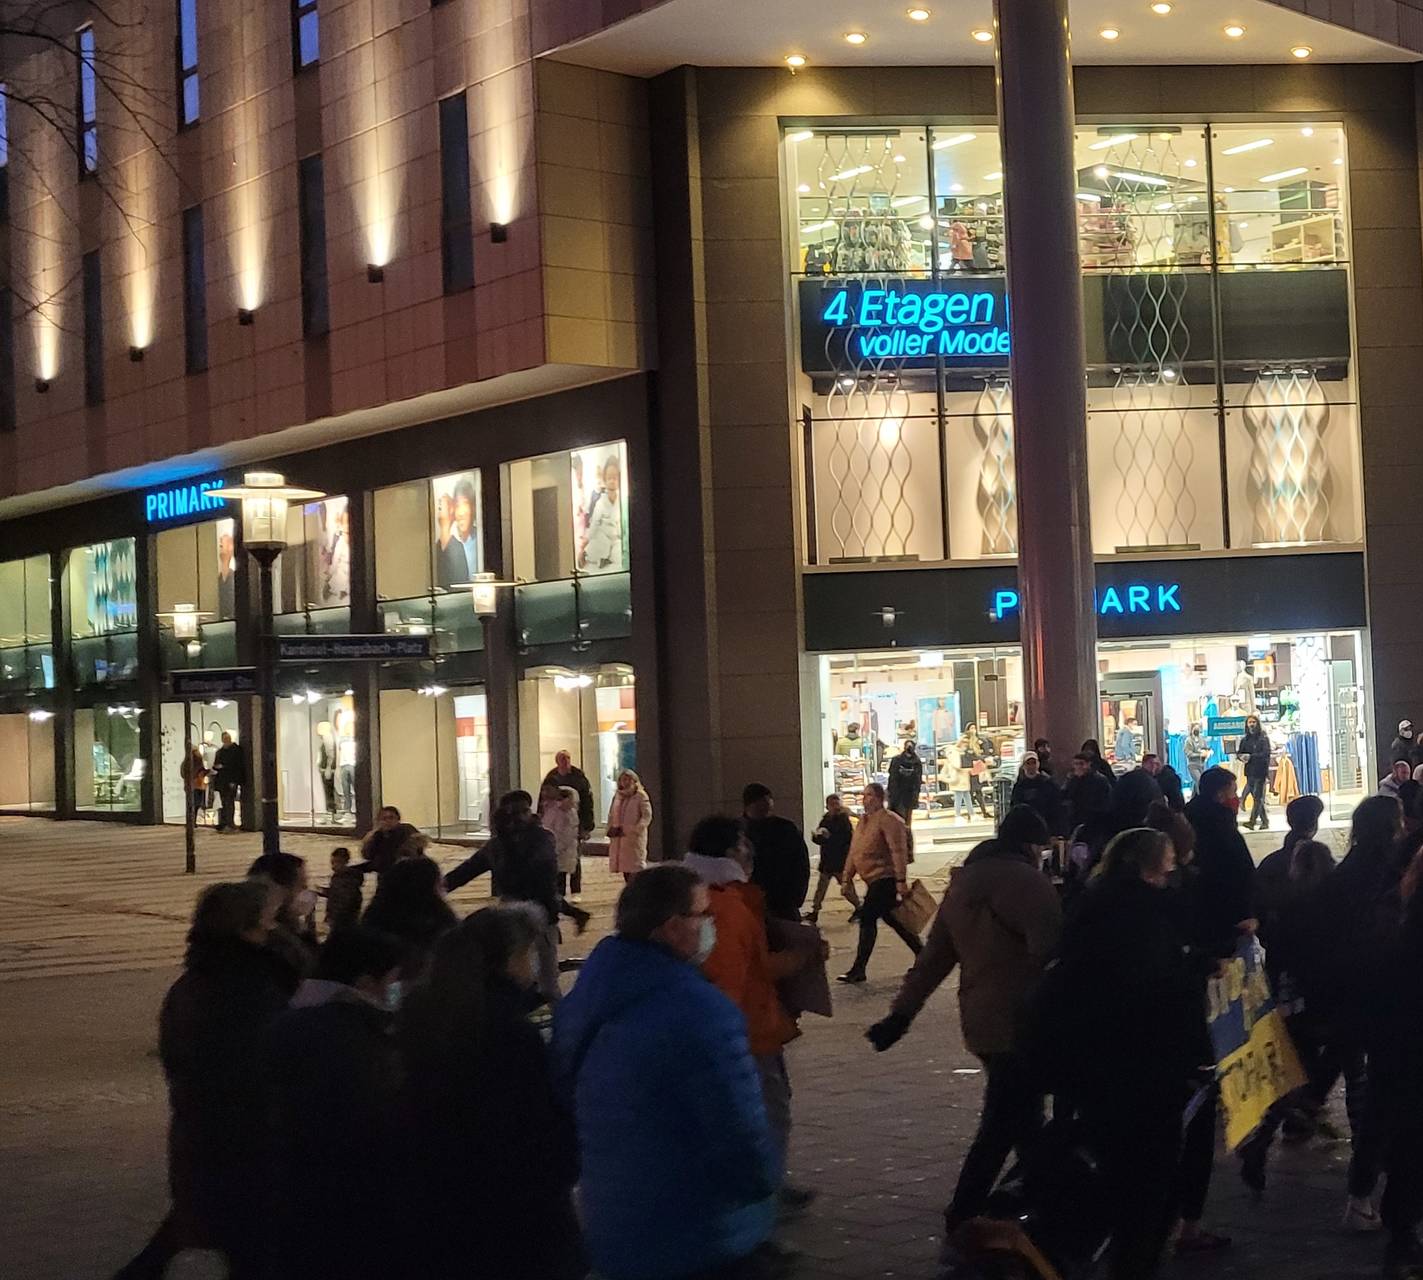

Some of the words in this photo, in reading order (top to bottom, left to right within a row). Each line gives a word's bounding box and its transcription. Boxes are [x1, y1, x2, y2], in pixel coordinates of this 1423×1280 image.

[824, 291, 848, 325] 4
[859, 290, 994, 333] Etagen
[860, 329, 934, 357] voller
[939, 327, 1011, 355] Mode
[146, 479, 225, 521] PRIMARK
[995, 584, 1181, 619] PARK
